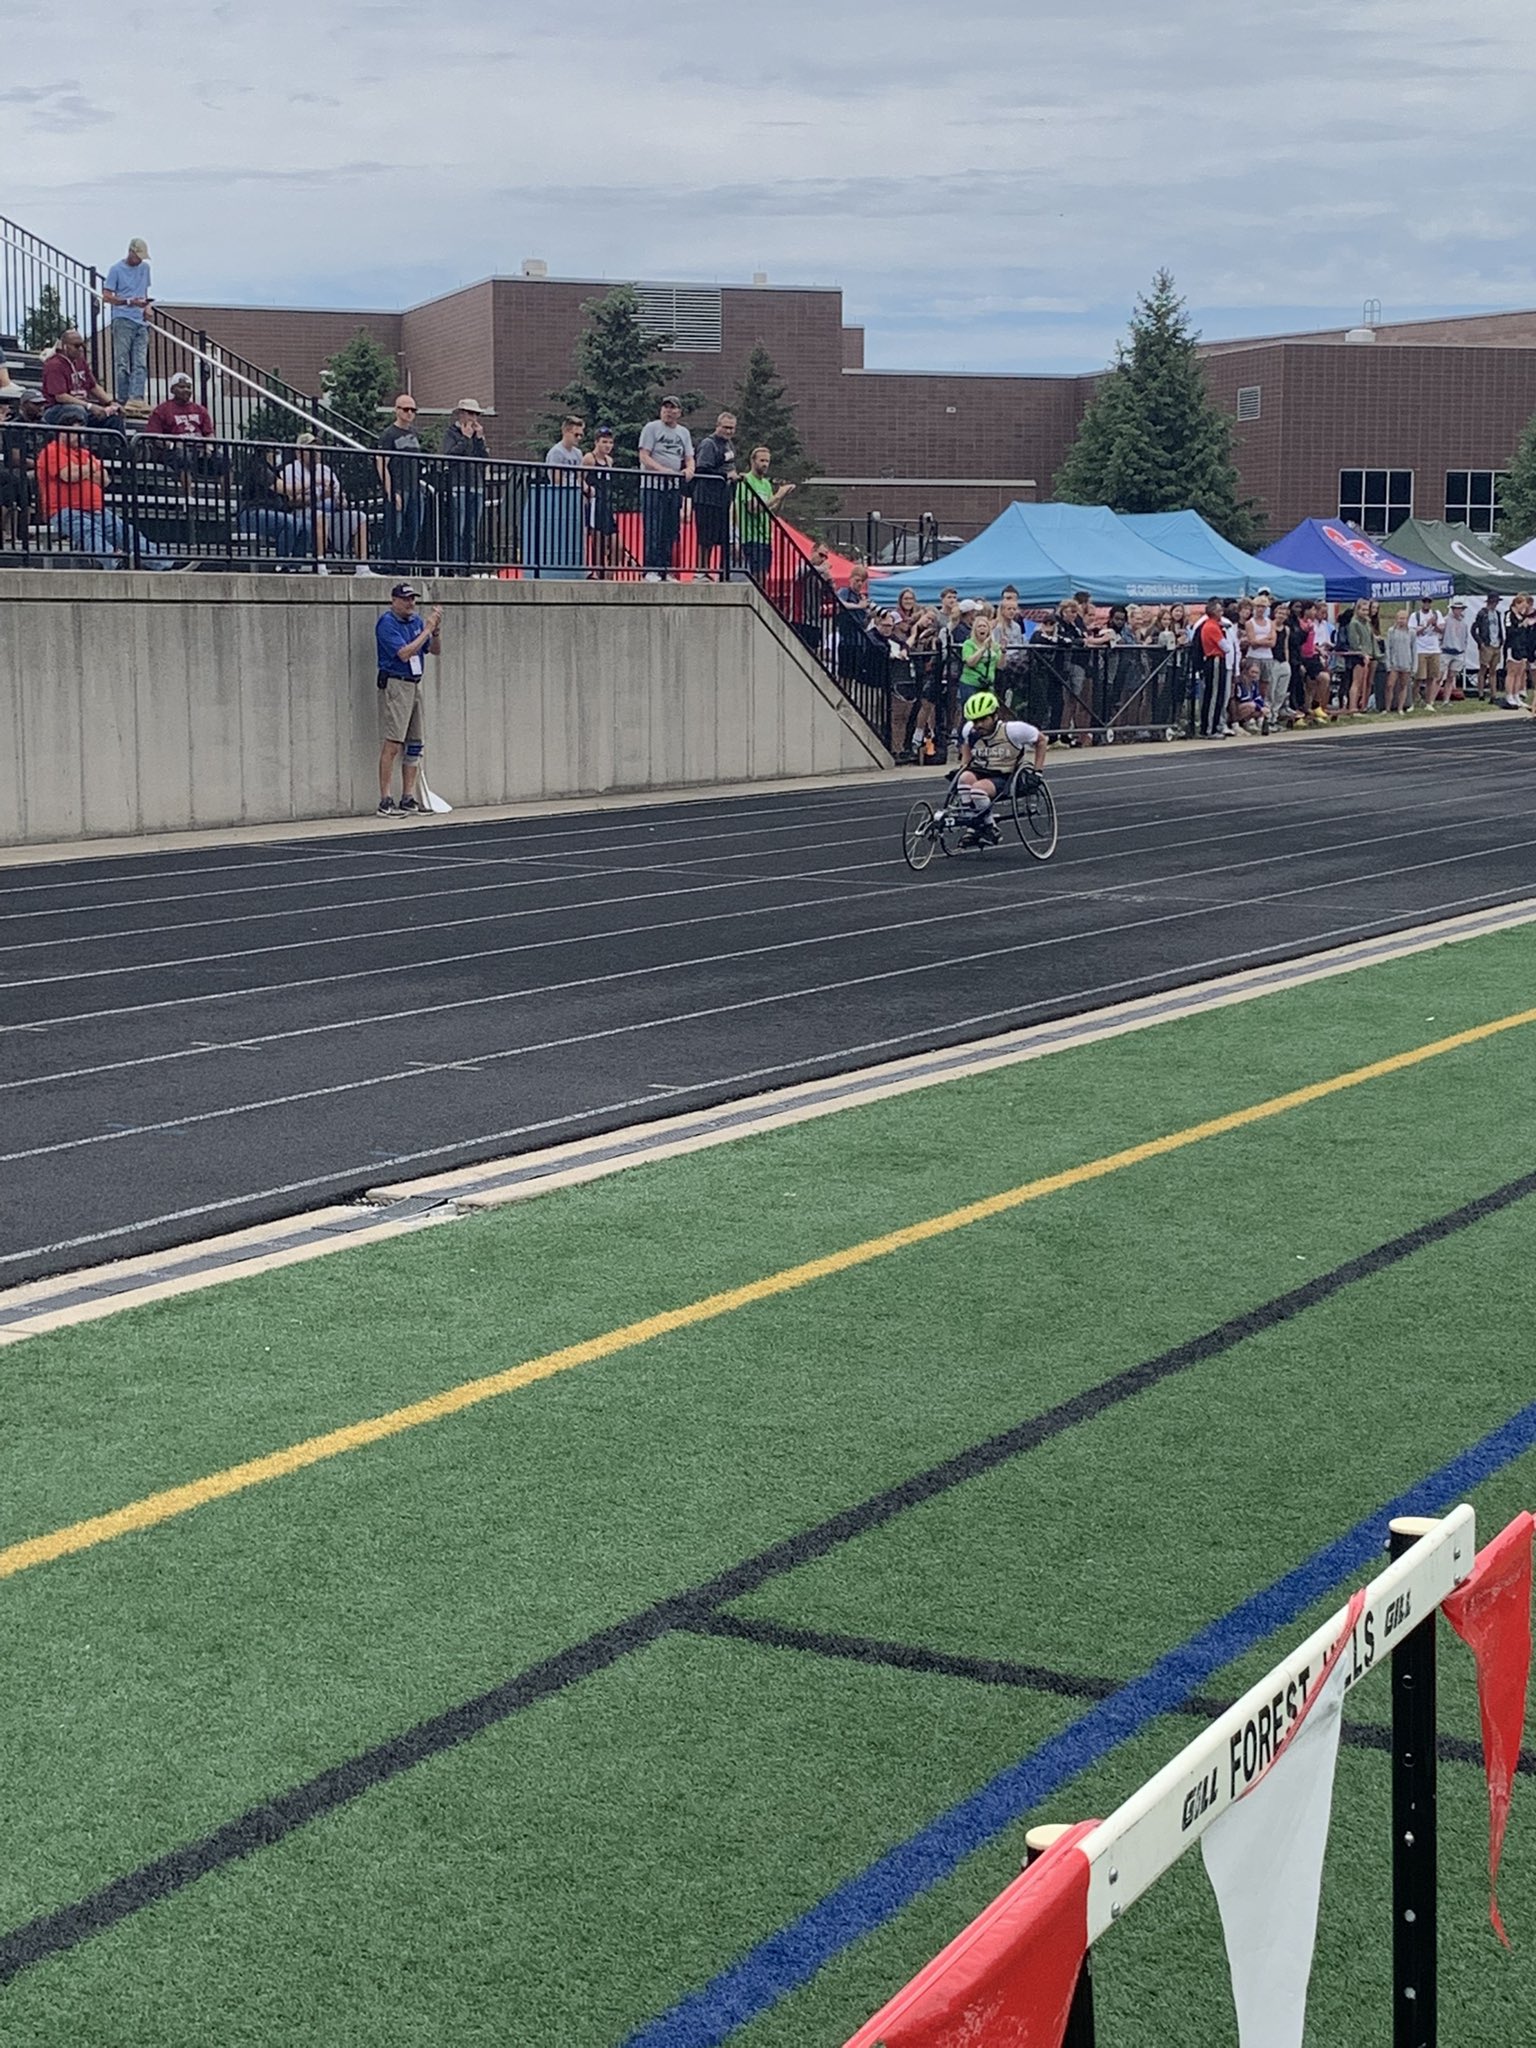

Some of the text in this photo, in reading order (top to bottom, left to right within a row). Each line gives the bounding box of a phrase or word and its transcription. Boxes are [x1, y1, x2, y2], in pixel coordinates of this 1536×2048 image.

[1182, 1588, 1411, 1832] GILL FOREST GILL
